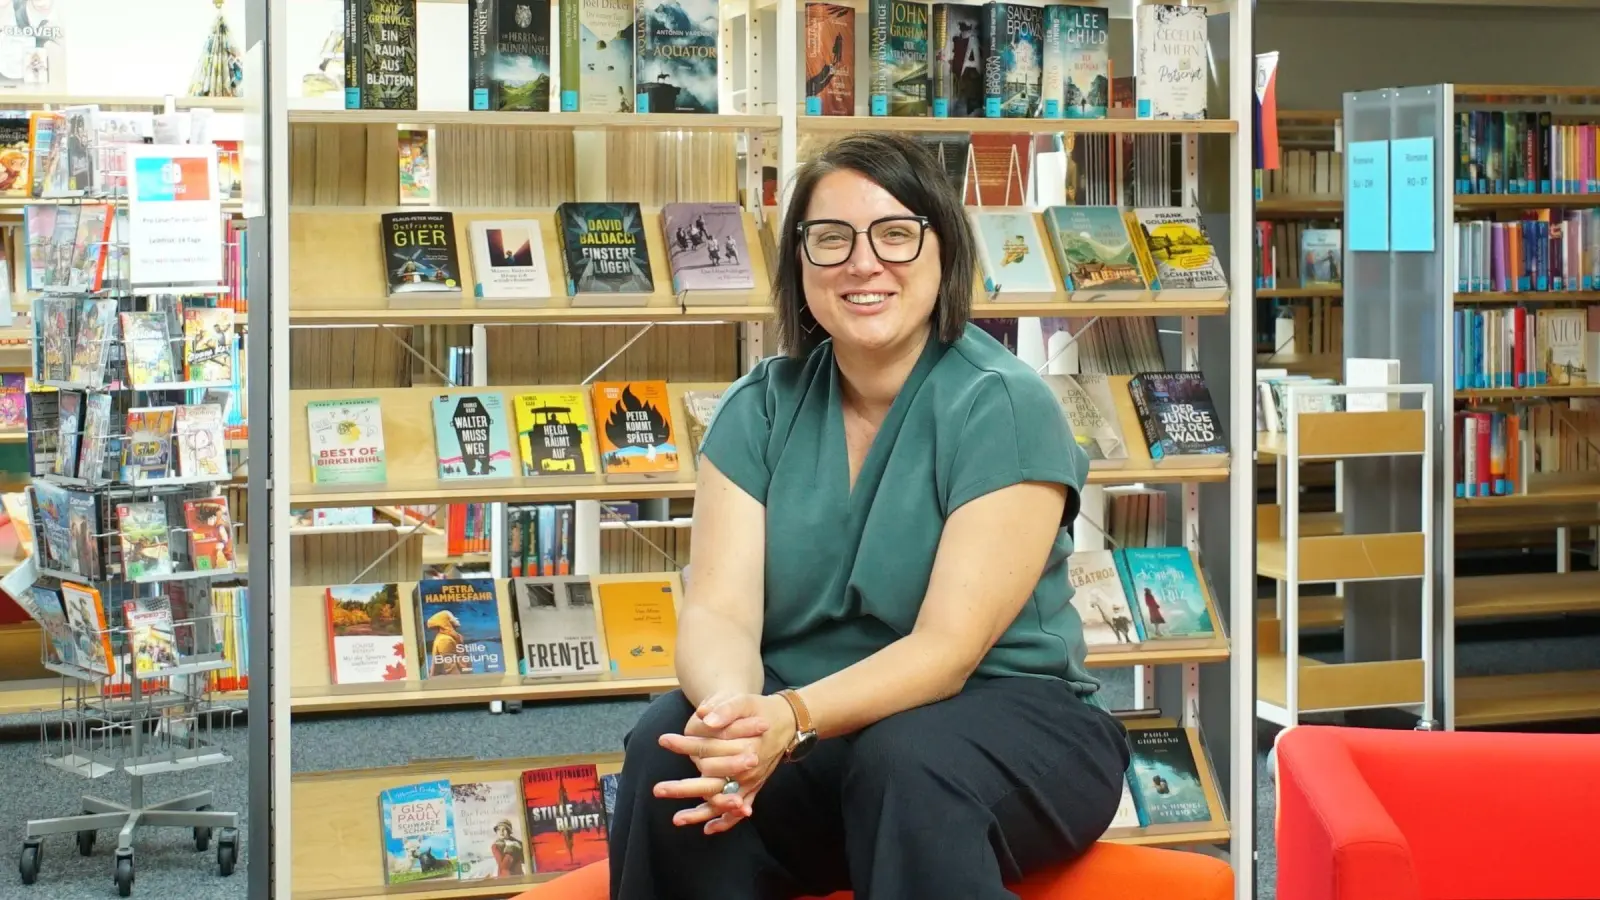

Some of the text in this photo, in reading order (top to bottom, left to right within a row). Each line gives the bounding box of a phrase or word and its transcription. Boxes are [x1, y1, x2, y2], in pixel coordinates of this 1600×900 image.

[380, 3, 398, 14] KATE
[891, 2, 927, 25] JOHN
[1007, 6, 1044, 22] SANDRA
[368, 14, 411, 26] GRENVILLE
[480, 9, 488, 35] INSEL
[1075, 13, 1099, 29] LEE
[4, 25, 63, 38] CLOVER
[381, 30, 398, 42] EIN
[890, 24, 927, 38] GRISHAM
[1007, 20, 1044, 39] BROWN
[1156, 28, 1204, 42] CECELIA
[1067, 28, 1107, 45] CHILD
[374, 44, 405, 56] RAUM
[653, 43, 717, 59] ÄQUATOR
[1161, 43, 1200, 56] AHERN
[380, 59, 400, 72] AUS
[366, 73, 414, 87] BLÄTTERN
[1158, 65, 1204, 83] Postscript
[587, 219, 622, 232] DAVID
[393, 229, 447, 247] GIER
[579, 232, 636, 245] BALDACCI
[582, 248, 636, 260] FINSTERE
[594, 260, 631, 274] LÜGEN
[1163, 270, 1212, 278] SCHATTEN
[1552, 318, 1581, 341] NICO
[1171, 404, 1194, 413] DER
[454, 415, 488, 428] WALTER
[626, 411, 648, 421] PETER
[1161, 412, 1212, 424] JUNGE
[543, 424, 568, 436] HELGA
[626, 421, 652, 431] KOMMT
[1165, 422, 1214, 433] AUS DEM
[461, 429, 488, 442] MUSS
[544, 435, 570, 448] RÄUMT
[626, 431, 654, 444] SPÄTER
[1170, 430, 1215, 443] WALD
[320, 447, 378, 458] BEST OF
[464, 443, 484, 455] WEG
[552, 448, 566, 459] AUF
[317, 456, 382, 466] BIRKENBIHL
[1070, 567, 1084, 576] DER
[1072, 567, 1115, 588] LBATROS
[442, 584, 474, 593] PETRA
[425, 592, 492, 603] HAMMESFAHR
[456, 643, 486, 653] Stille
[434, 652, 498, 665] Befreiung
[527, 641, 599, 670] FRENZEL
[1137, 737, 1179, 745] GIORDANO
[528, 770, 553, 783] URSULA
[401, 803, 434, 814] GISA
[532, 804, 573, 821] STILLE
[398, 810, 440, 823] PAULY
[556, 813, 600, 831] BLUTET
[398, 820, 440, 830] SCHWARZE
[403, 826, 434, 834] SCHAFE
